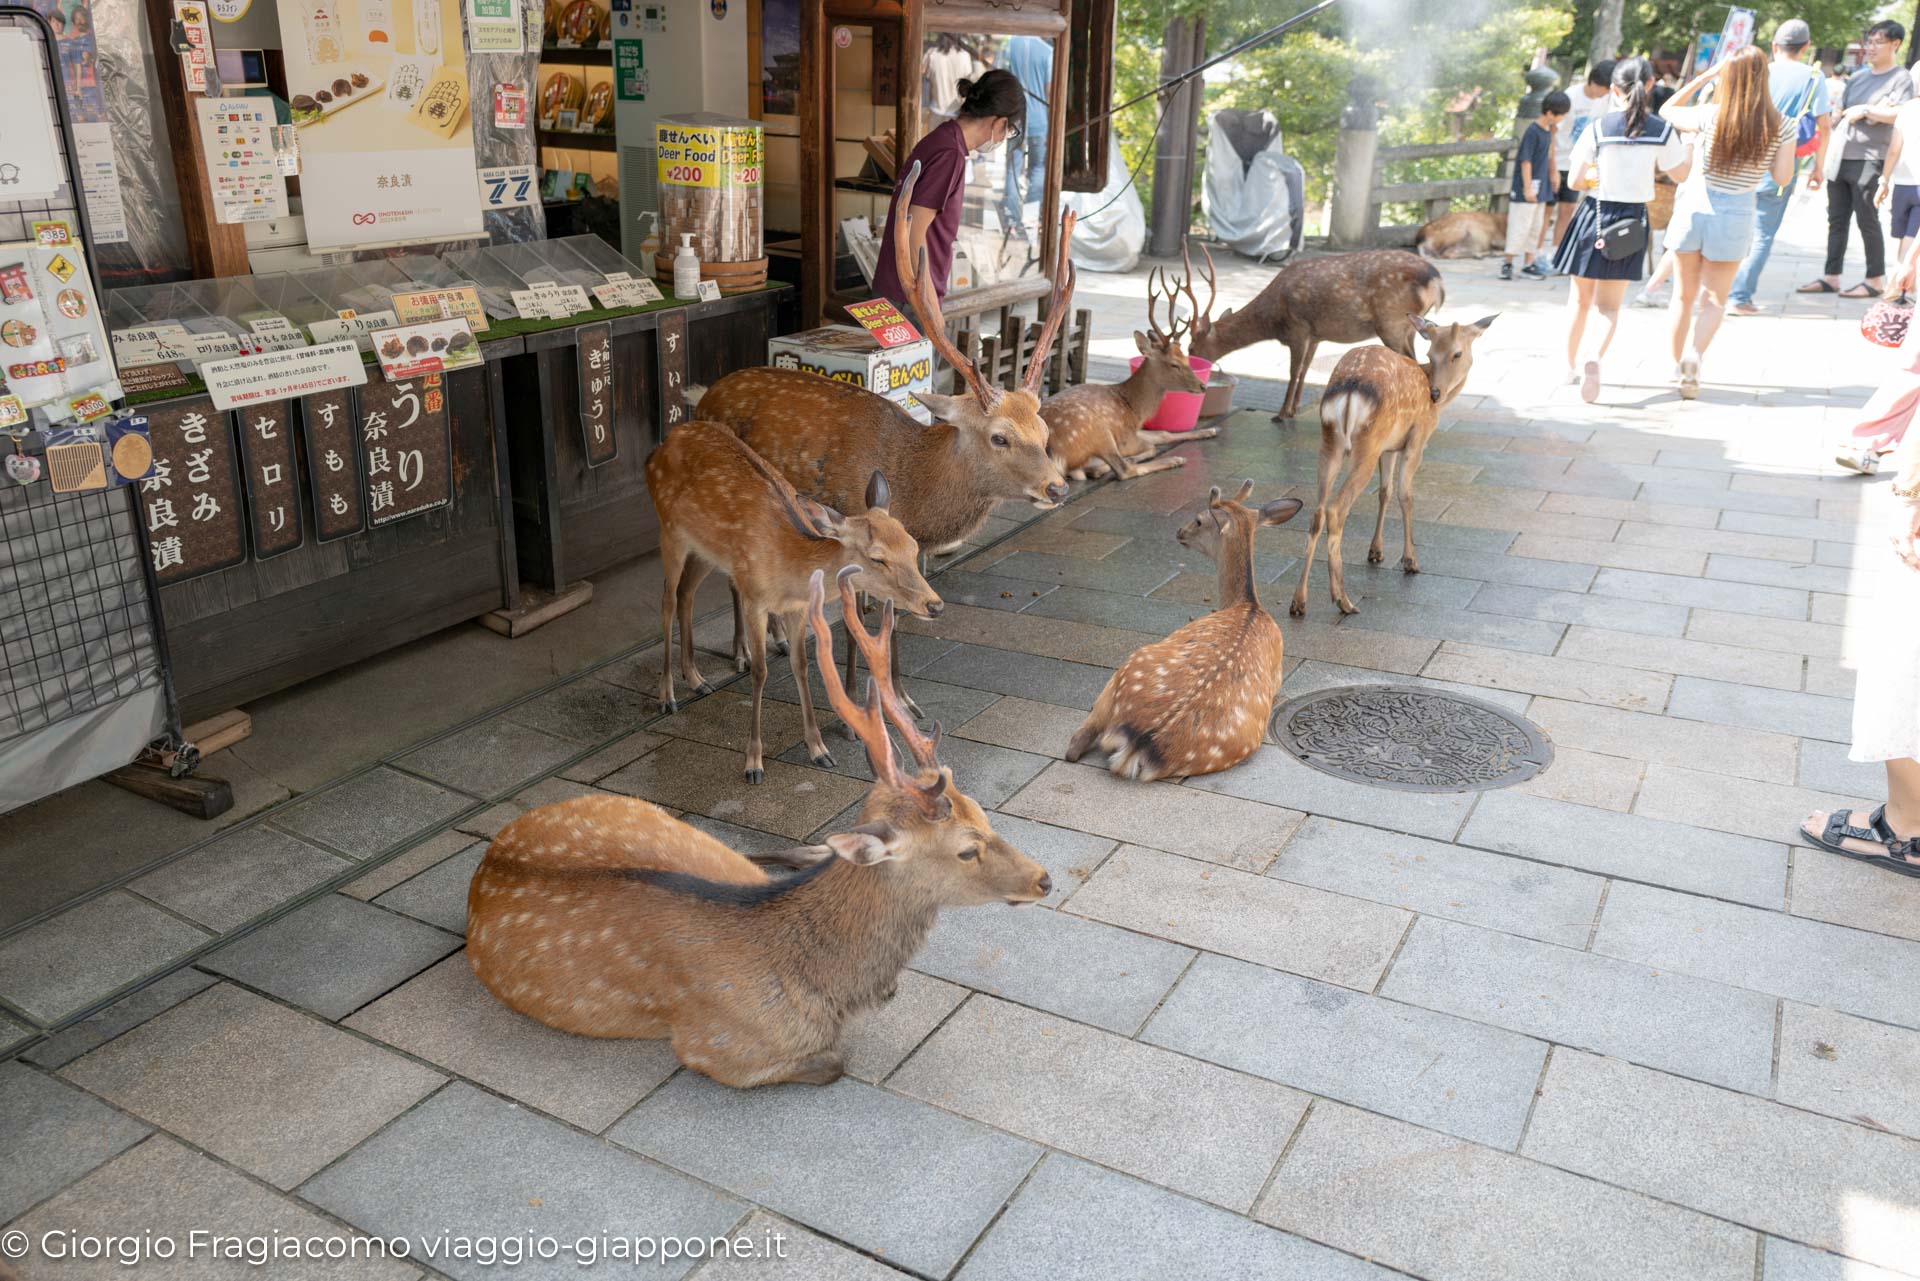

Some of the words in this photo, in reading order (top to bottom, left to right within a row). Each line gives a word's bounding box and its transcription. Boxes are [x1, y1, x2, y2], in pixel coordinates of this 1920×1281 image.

[659, 129, 715, 144] 鹿せんべい
[659, 146, 681, 160] Deer
[684, 148, 716, 162] Food
[666, 166, 702, 182] ¥200
[721, 149, 749, 164] Deer
[377, 174, 413, 188] 奈良漬
[254, 333, 279, 344] すもも
[862, 319, 884, 330] Deer
[881, 312, 905, 325] Food
[882, 325, 911, 343] ¥200
[601, 339, 611, 386] 大和三尺
[666, 332, 682, 424] すいか
[873, 360, 929, 395] 鹿せんべい
[392, 382, 424, 492] うり
[179, 412, 222, 523] きざみ
[254, 416, 285, 532] セロリ
[318, 403, 348, 516] すもも
[363, 411, 396, 512] 奈良漬
[141, 457, 185, 572] 奈良漬
